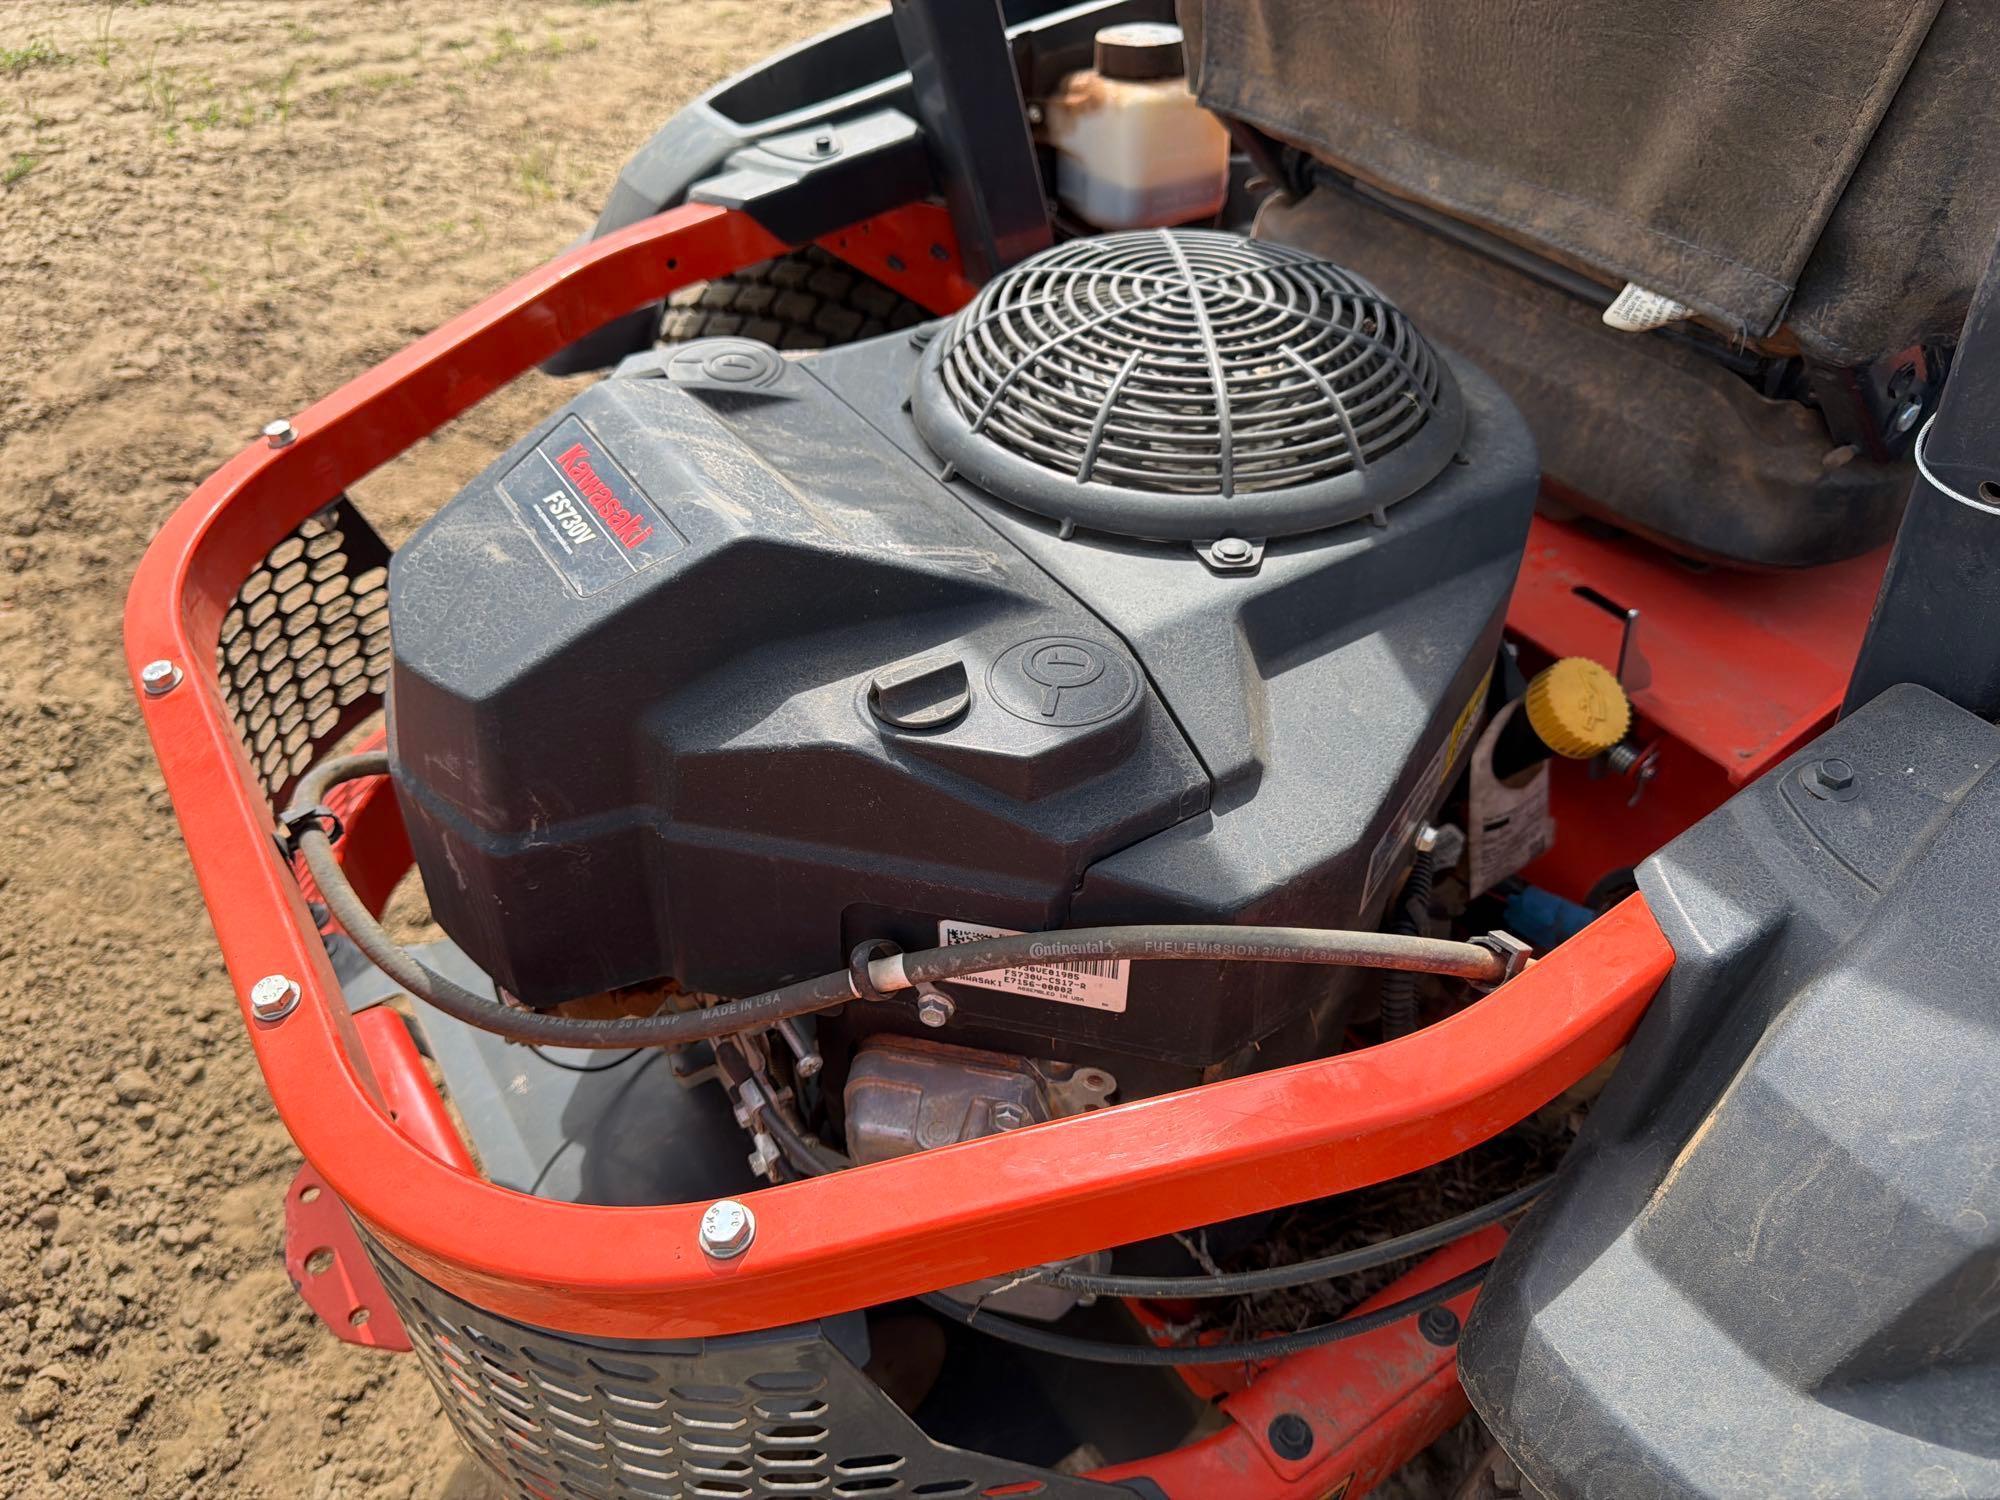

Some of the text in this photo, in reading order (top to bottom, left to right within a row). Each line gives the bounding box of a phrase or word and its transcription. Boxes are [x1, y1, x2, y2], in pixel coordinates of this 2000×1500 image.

[555, 442, 654, 550] Kawasaki
[541, 489, 598, 545] FS730V
[1028, 939, 1109, 960] Continental
[1143, 940, 1258, 956] FUEL/EMISSION
[1003, 975, 1073, 995] E7156-00002
[1004, 969, 1087, 990] FS730V-CS17-R
[701, 999, 737, 1021] MADE
[740, 999, 752, 1012] IN
[755, 991, 782, 1008] USA
